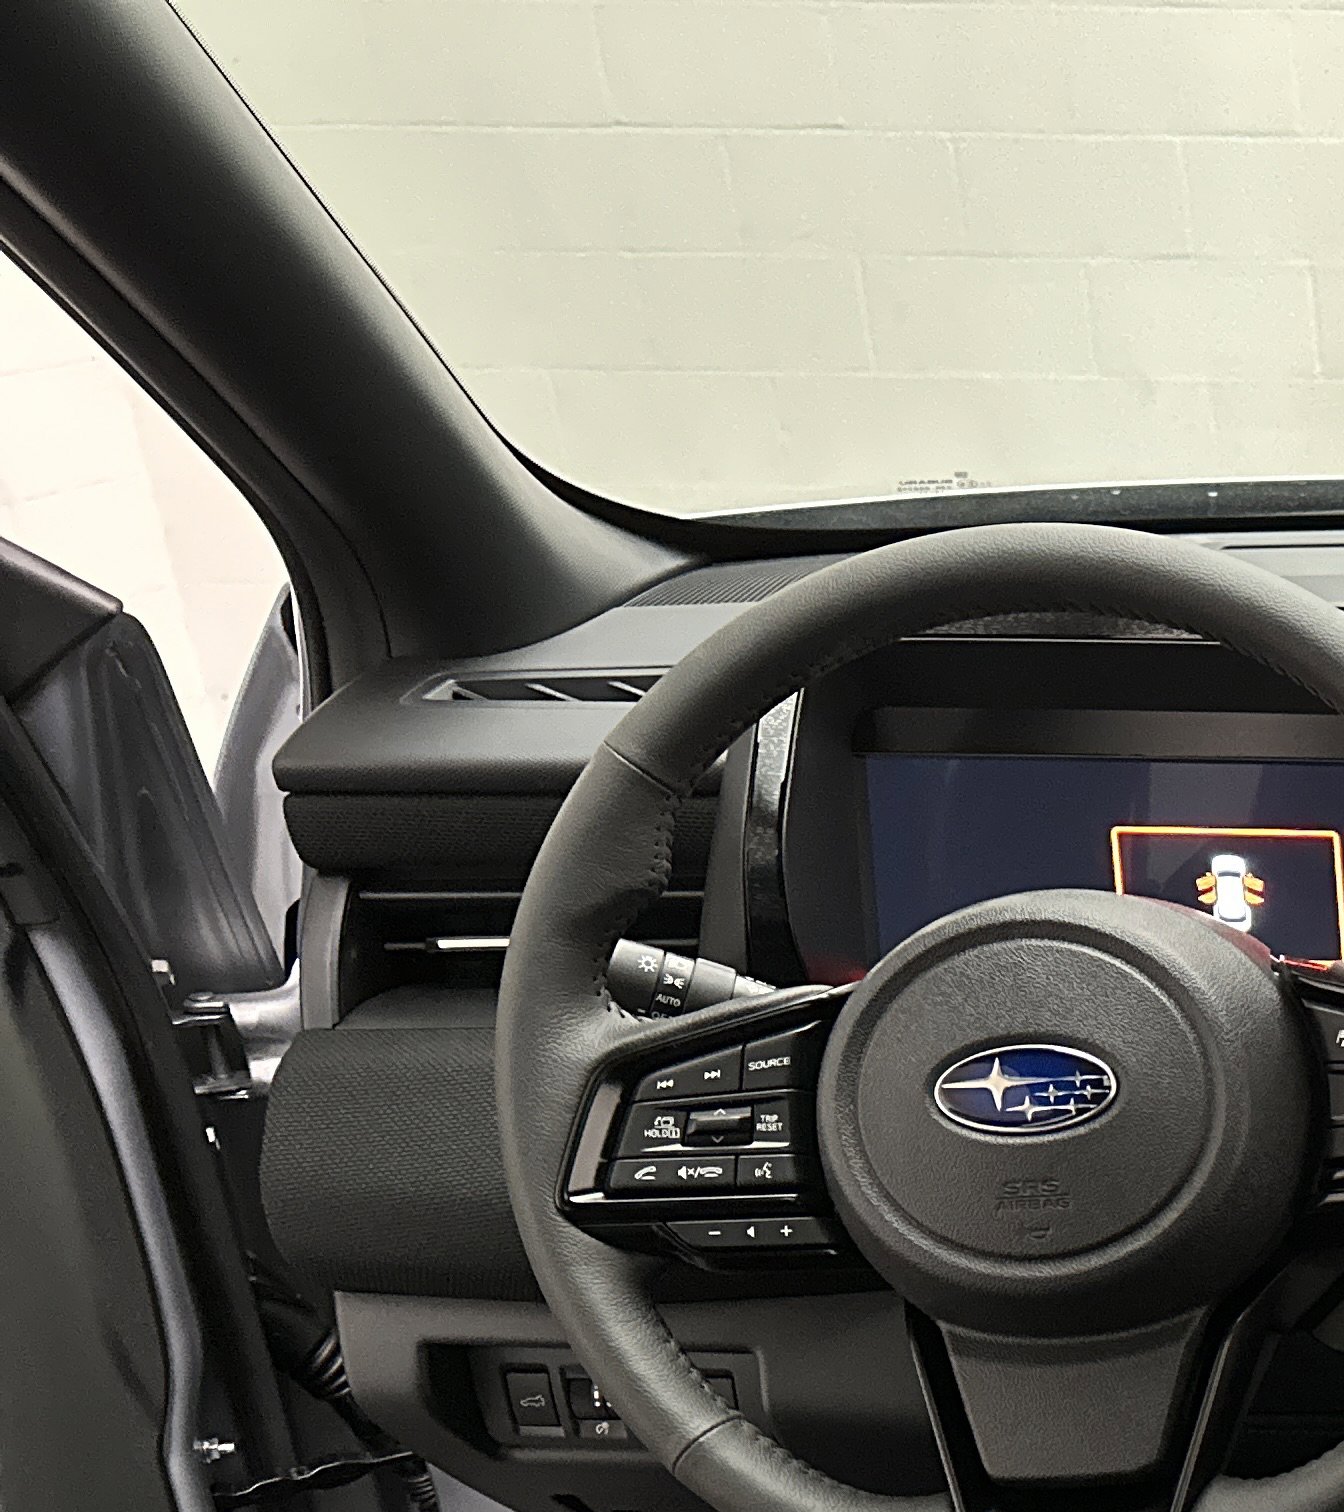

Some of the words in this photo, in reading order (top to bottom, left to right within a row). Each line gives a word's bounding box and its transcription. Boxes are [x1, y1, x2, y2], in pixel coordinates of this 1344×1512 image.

[656, 993, 681, 1007] AUTO
[748, 1056, 791, 1071] SOURCE
[760, 1113, 779, 1122] TRIP
[756, 1122, 783, 1132] RESET
[1002, 1178, 1060, 1196] SRS
